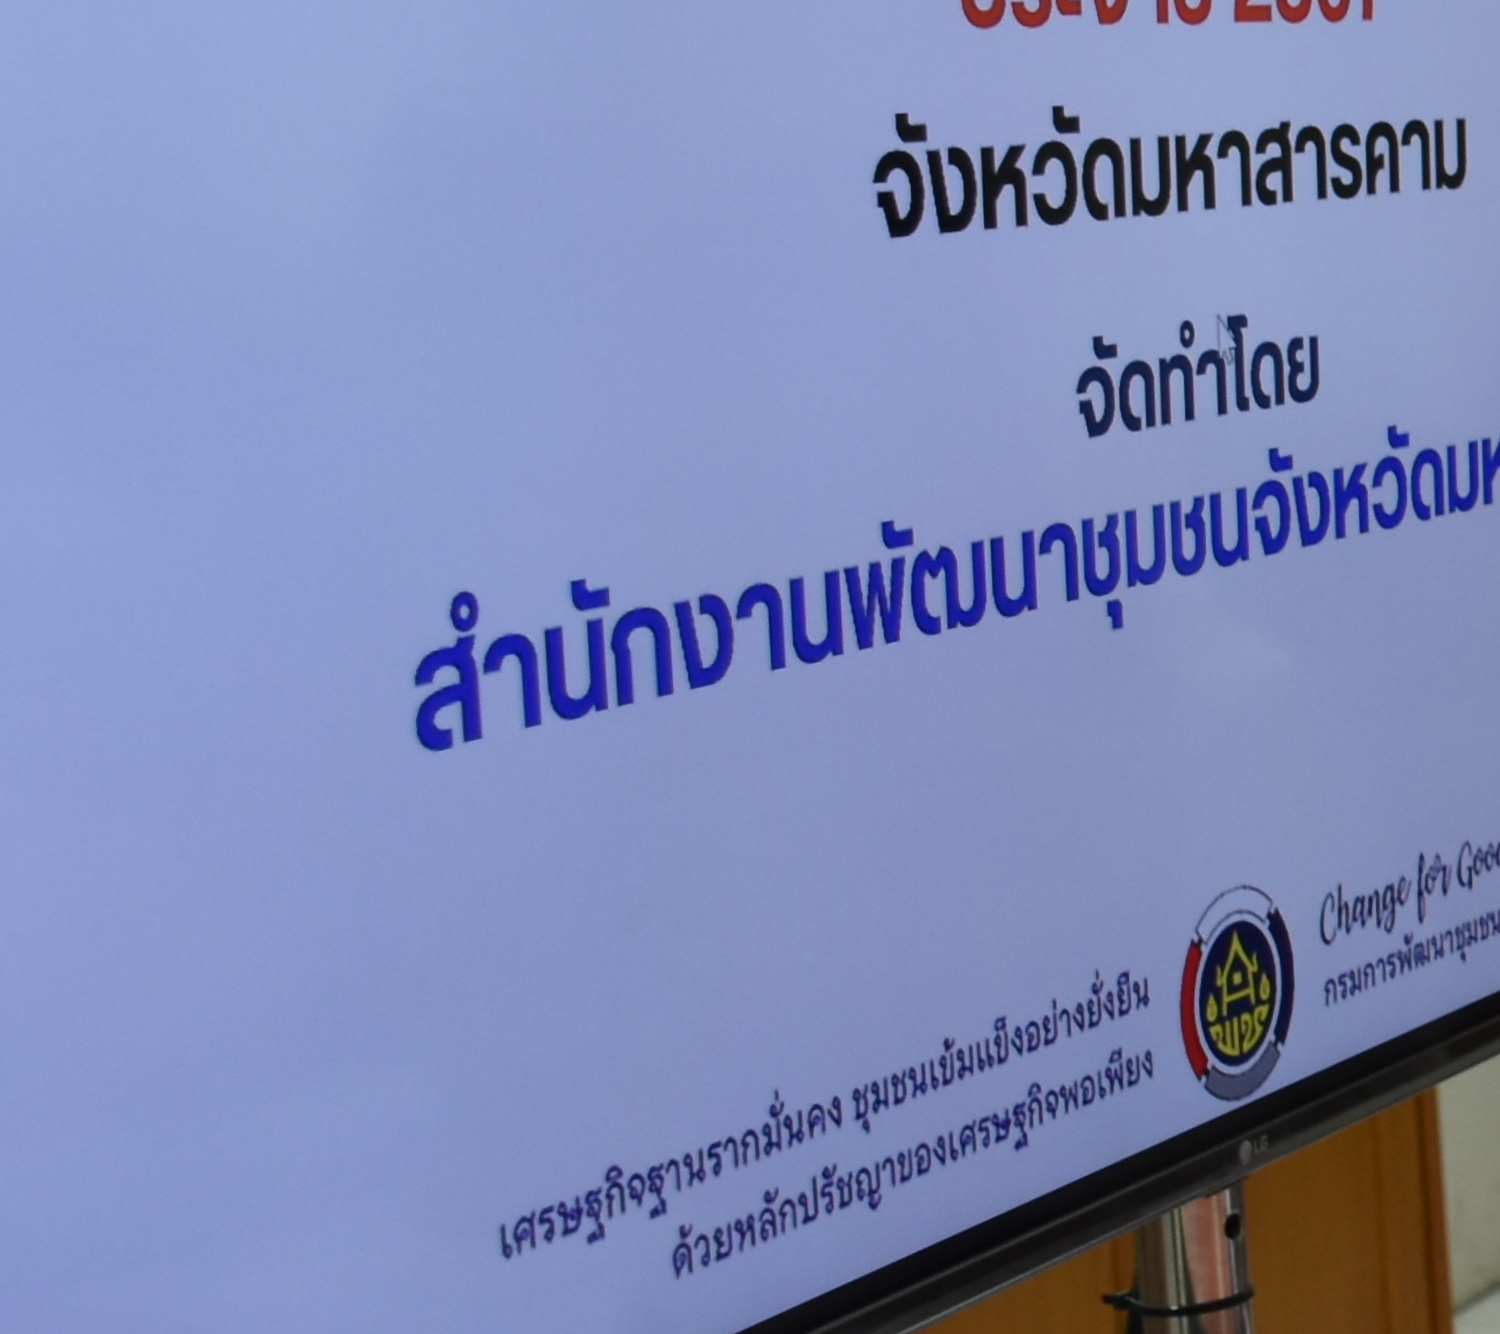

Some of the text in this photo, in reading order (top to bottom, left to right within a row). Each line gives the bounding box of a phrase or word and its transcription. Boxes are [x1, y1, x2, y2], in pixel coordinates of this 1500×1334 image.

[871, 104, 1468, 240] จังหวัดมหาสารคาม
[1075, 313, 1320, 440] จัดทำโดย
[1319, 876, 1410, 947] Change
[1416, 852, 1451, 925] for
[499, 969, 1151, 1261] เศรษฐกิจฐานรากมั่นคง ชุมชนเข้มแข็งอย่างยั่งยืน
[671, 1047, 1154, 1280] ด้วยหลักปรัชญาของเศรษฐกิจพอเพียง
